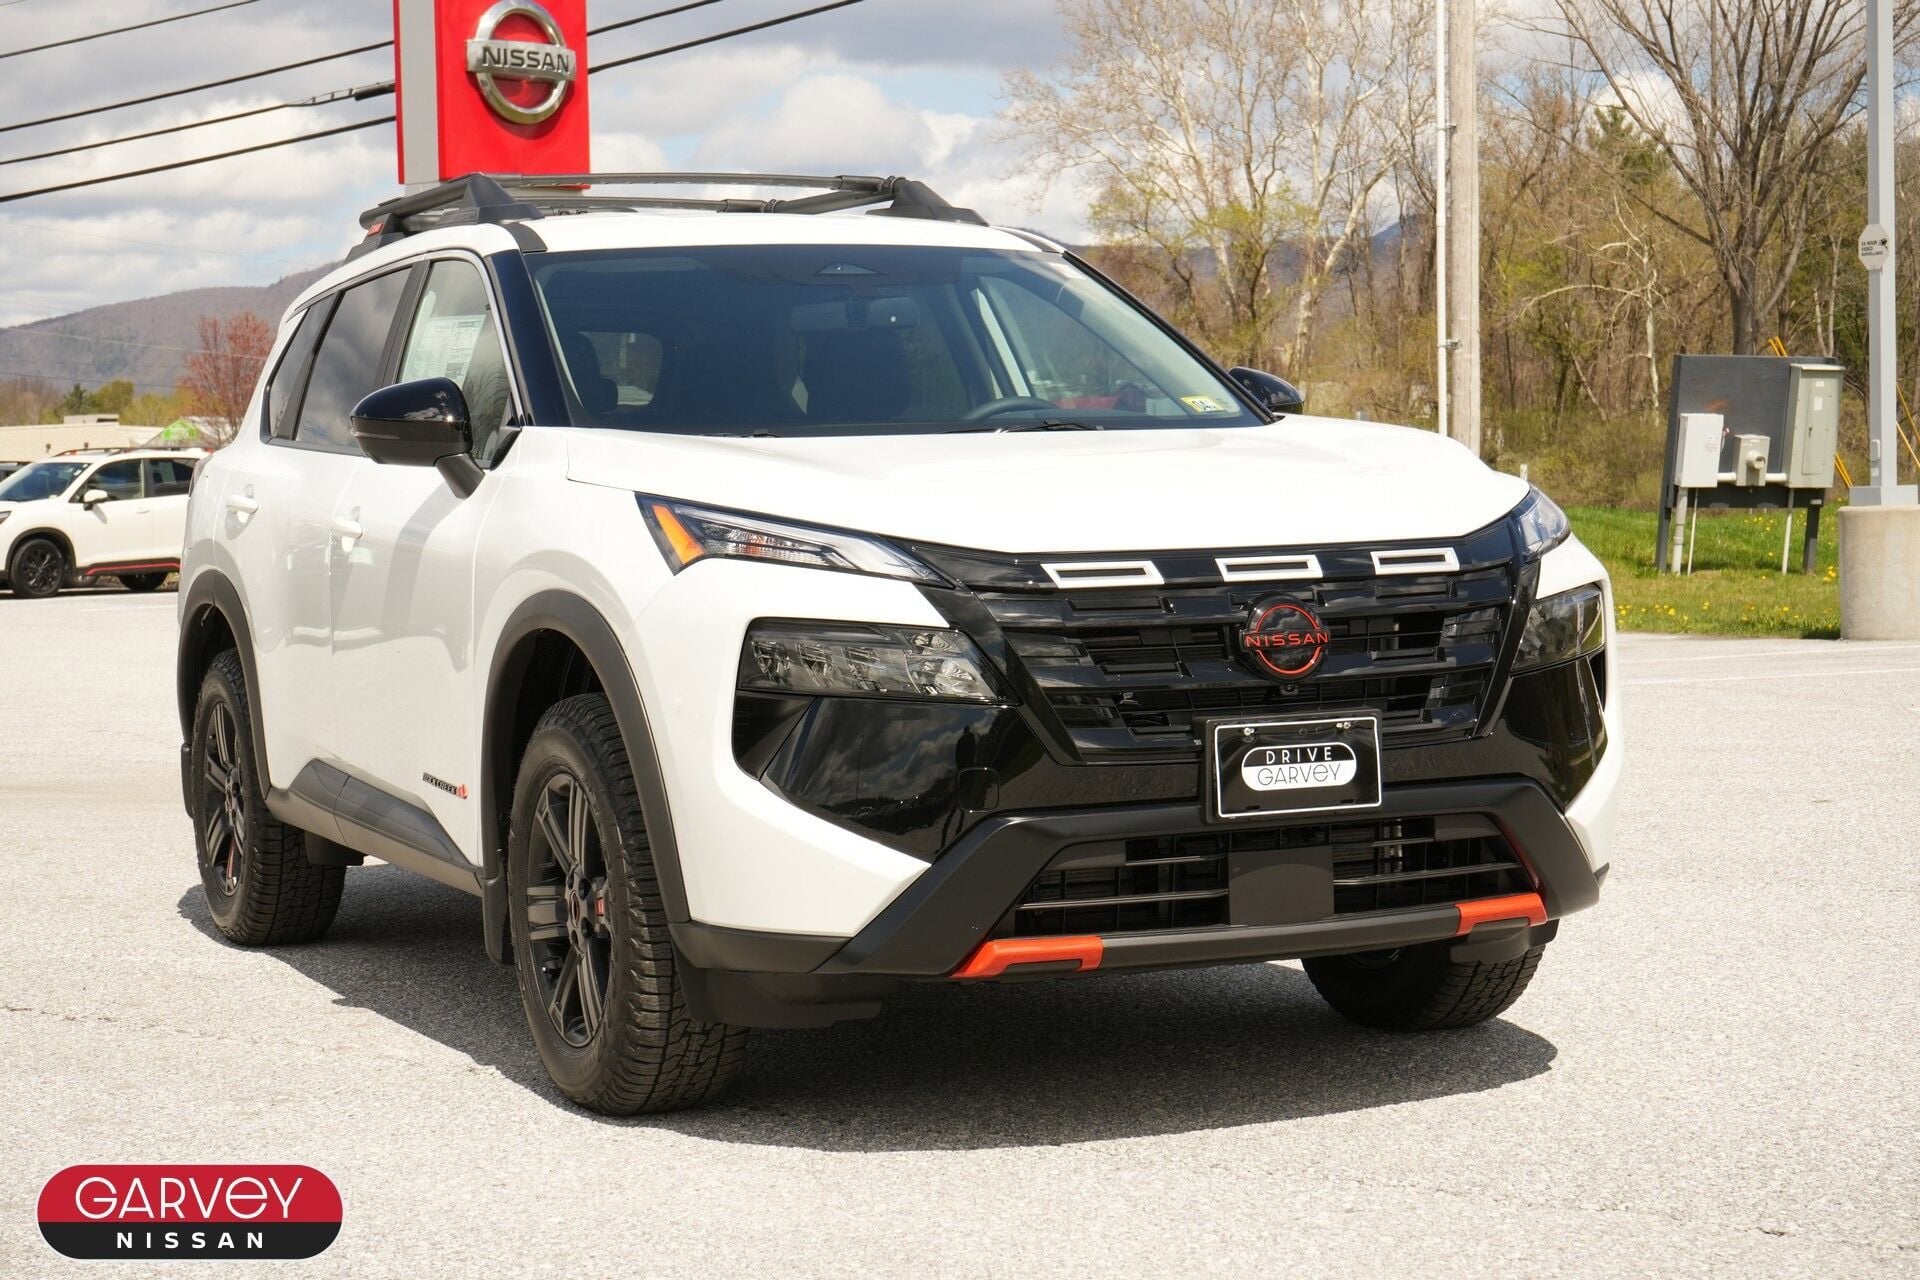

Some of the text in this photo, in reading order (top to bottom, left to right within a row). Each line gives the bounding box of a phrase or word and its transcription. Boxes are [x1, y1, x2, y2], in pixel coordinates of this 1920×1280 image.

[481, 46, 569, 73] NISSAN
[1245, 631, 1329, 648] NISSAN
[1266, 746, 1332, 765] DRIVE
